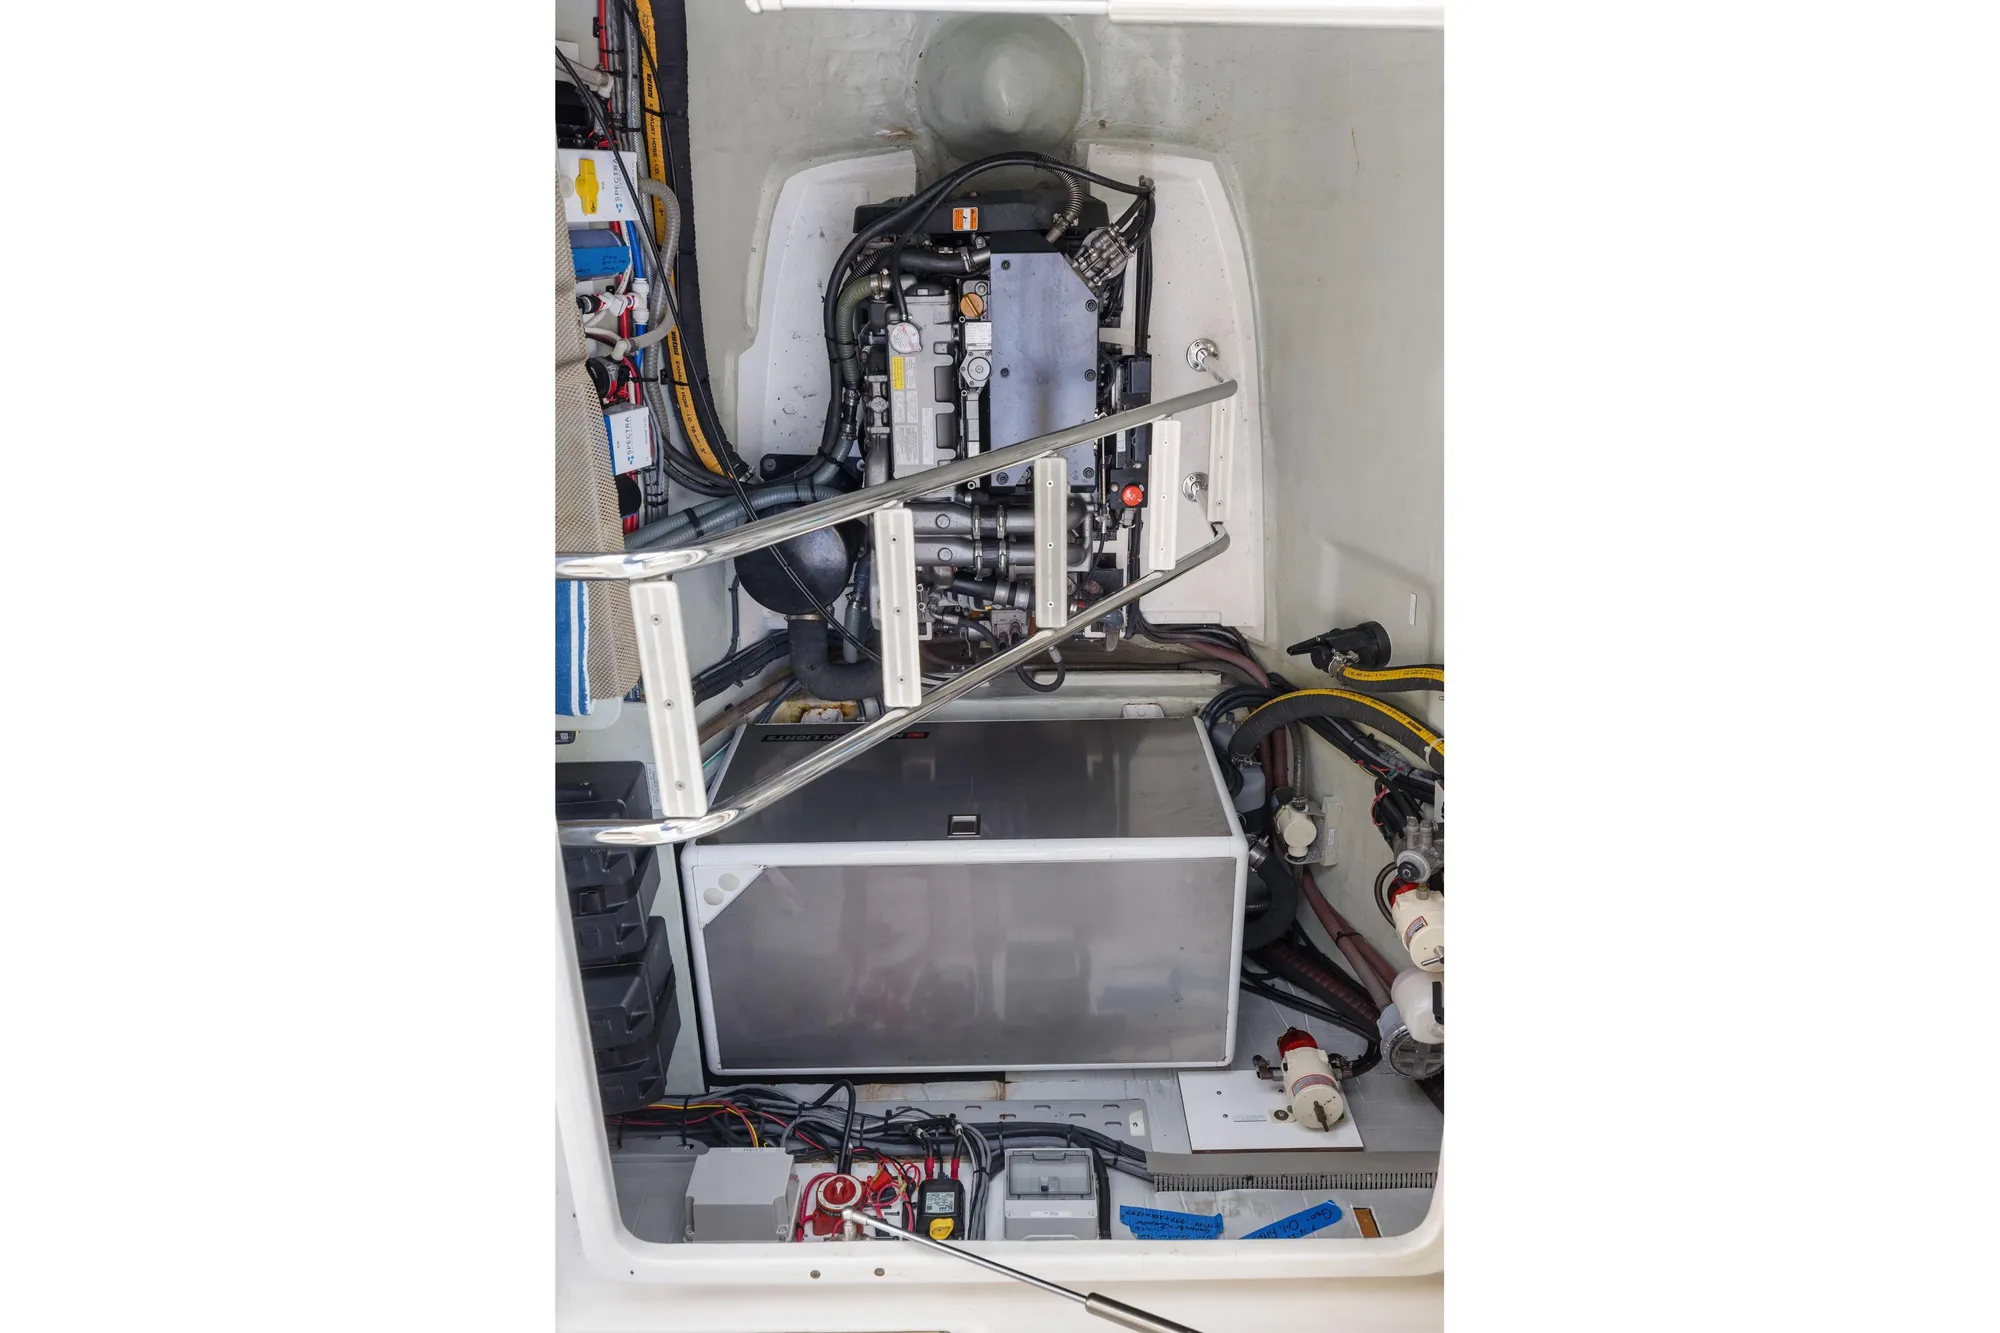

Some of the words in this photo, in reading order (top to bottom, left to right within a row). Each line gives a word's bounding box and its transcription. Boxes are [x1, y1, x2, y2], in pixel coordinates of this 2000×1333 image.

[649, 103, 657, 135] EAUST
[675, 360, 685, 390] EXHAUT
[681, 391, 689, 409] HOSE
